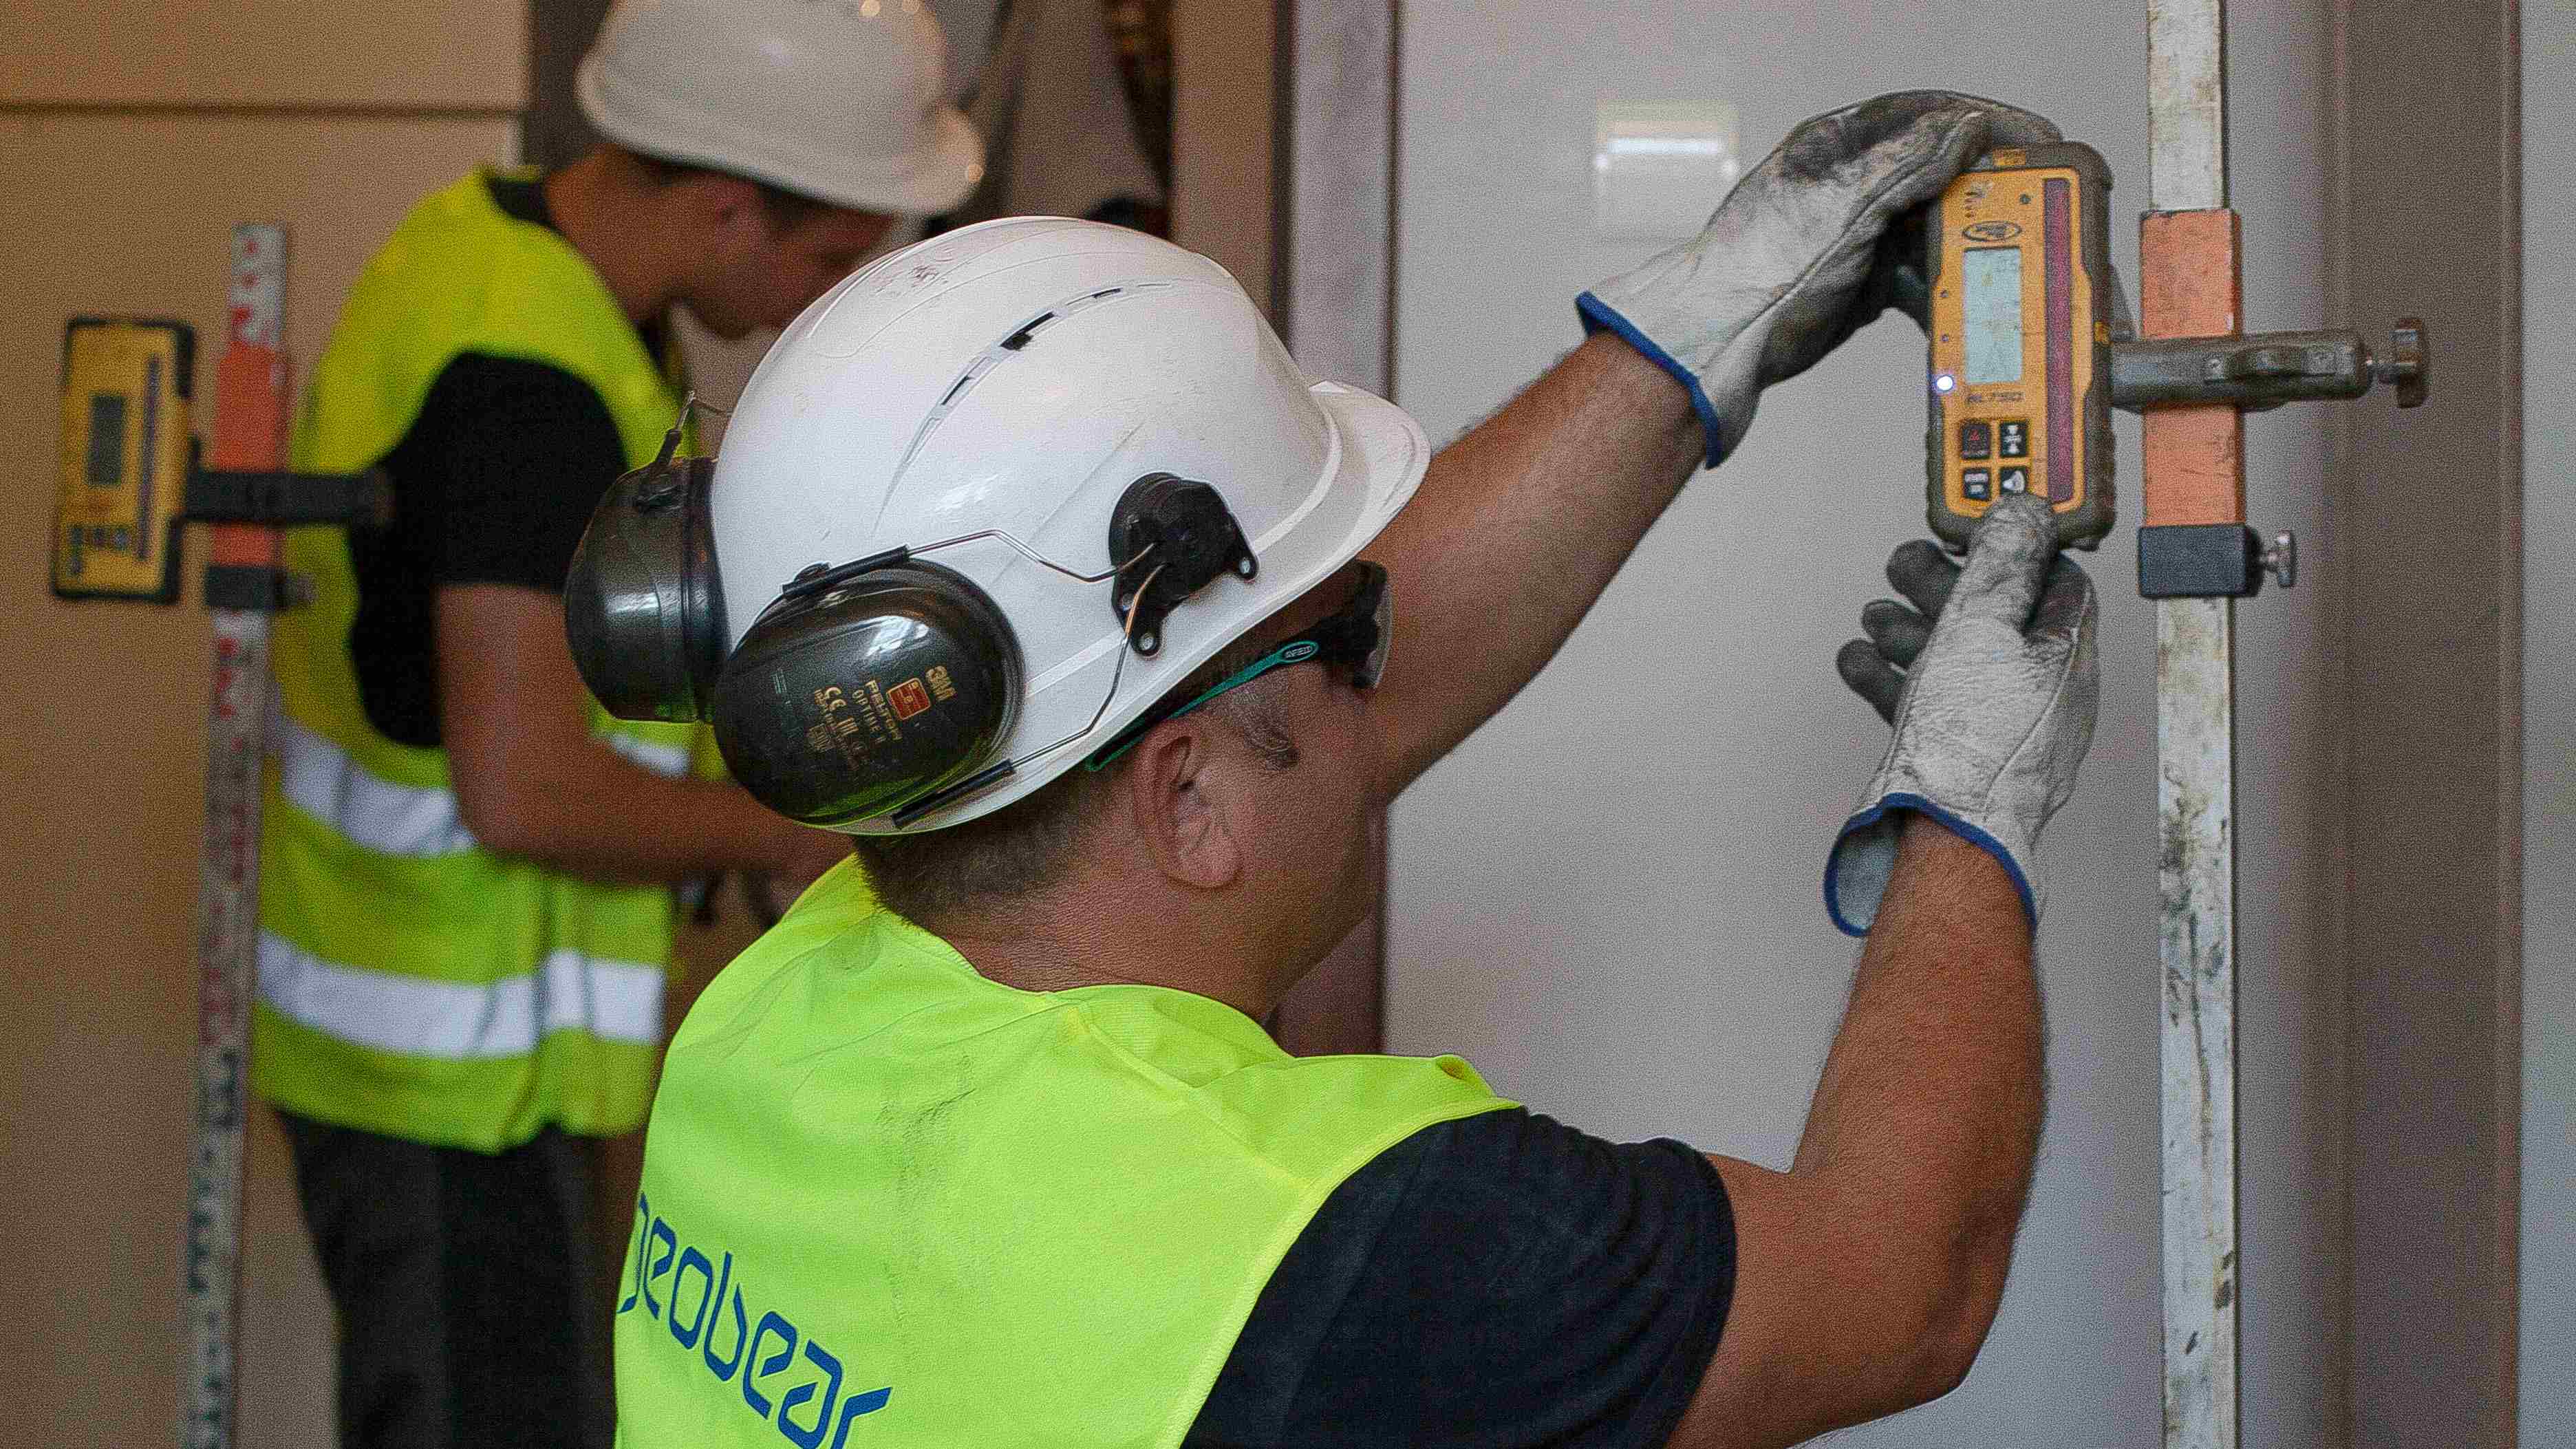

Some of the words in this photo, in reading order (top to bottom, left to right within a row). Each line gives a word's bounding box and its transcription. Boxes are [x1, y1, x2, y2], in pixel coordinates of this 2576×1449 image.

[925, 665, 957, 702] 3M
[851, 688, 882, 733] OPTIME
[863, 679, 904, 742] PELTOR
